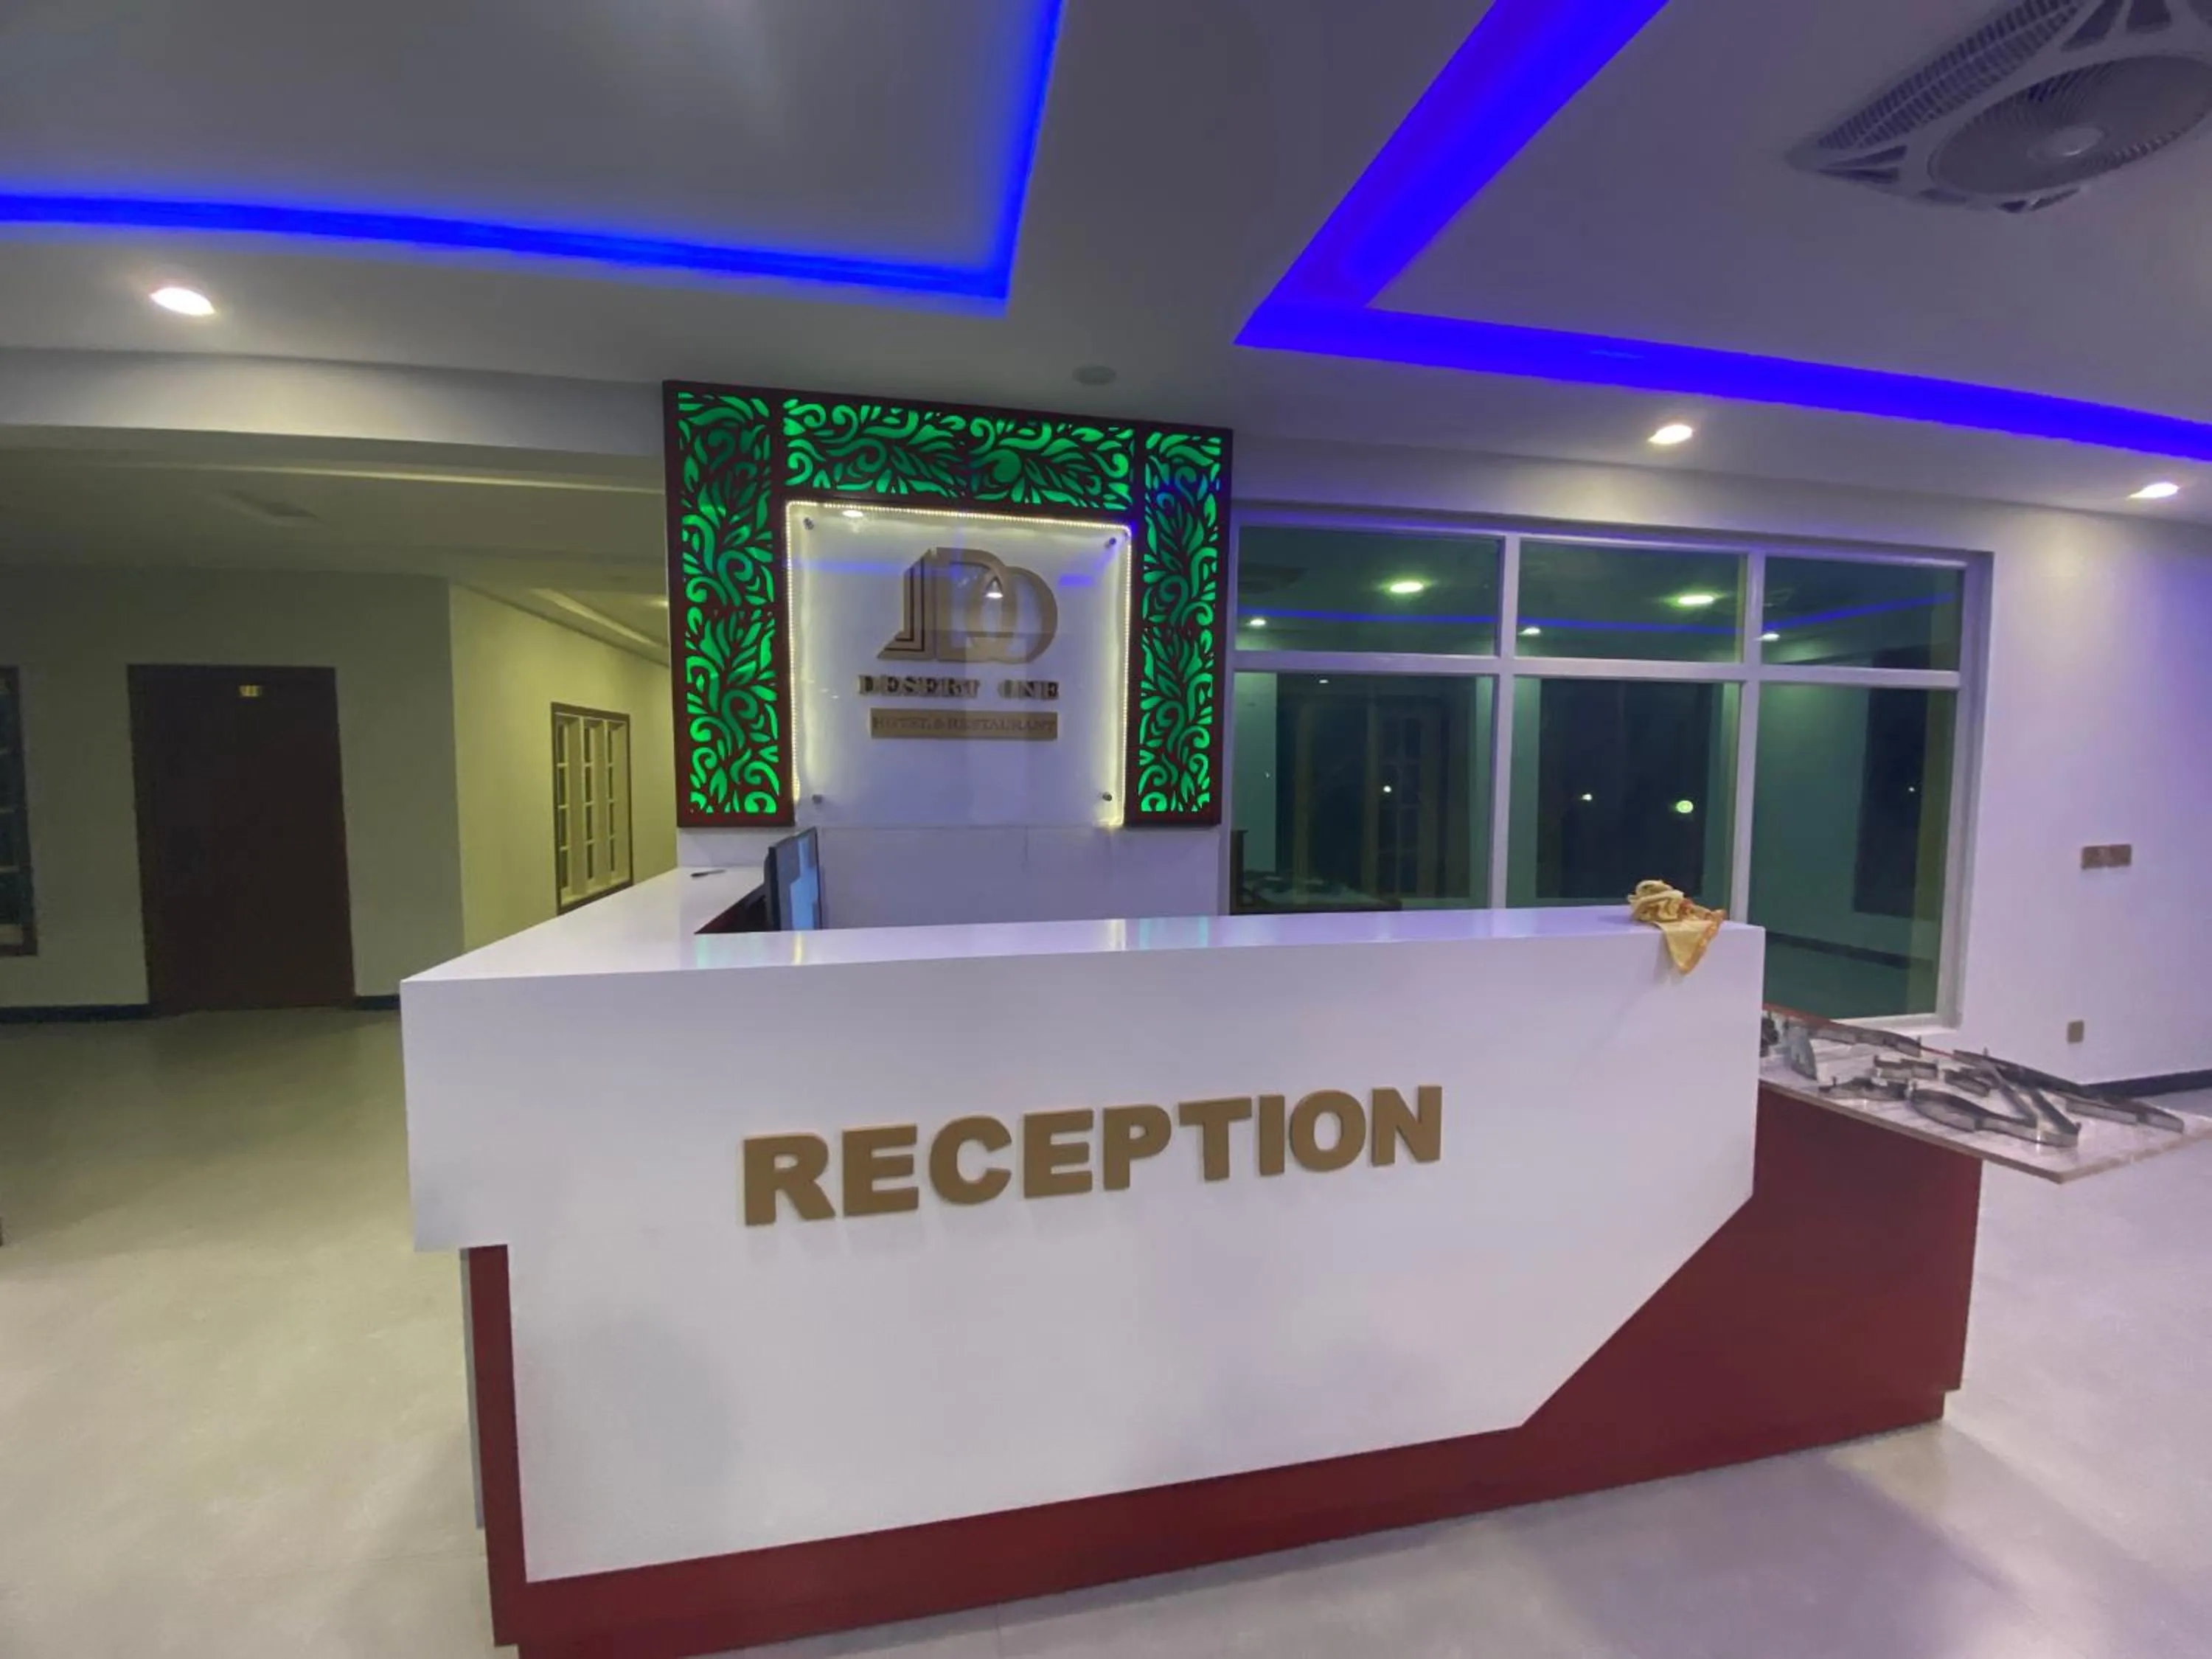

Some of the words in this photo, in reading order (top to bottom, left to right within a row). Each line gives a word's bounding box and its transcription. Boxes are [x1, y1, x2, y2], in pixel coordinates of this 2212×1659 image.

[858, 674, 979, 698] DESERT
[998, 678, 1060, 700] ONE
[742, 1085, 1443, 1227] RECEPTION
